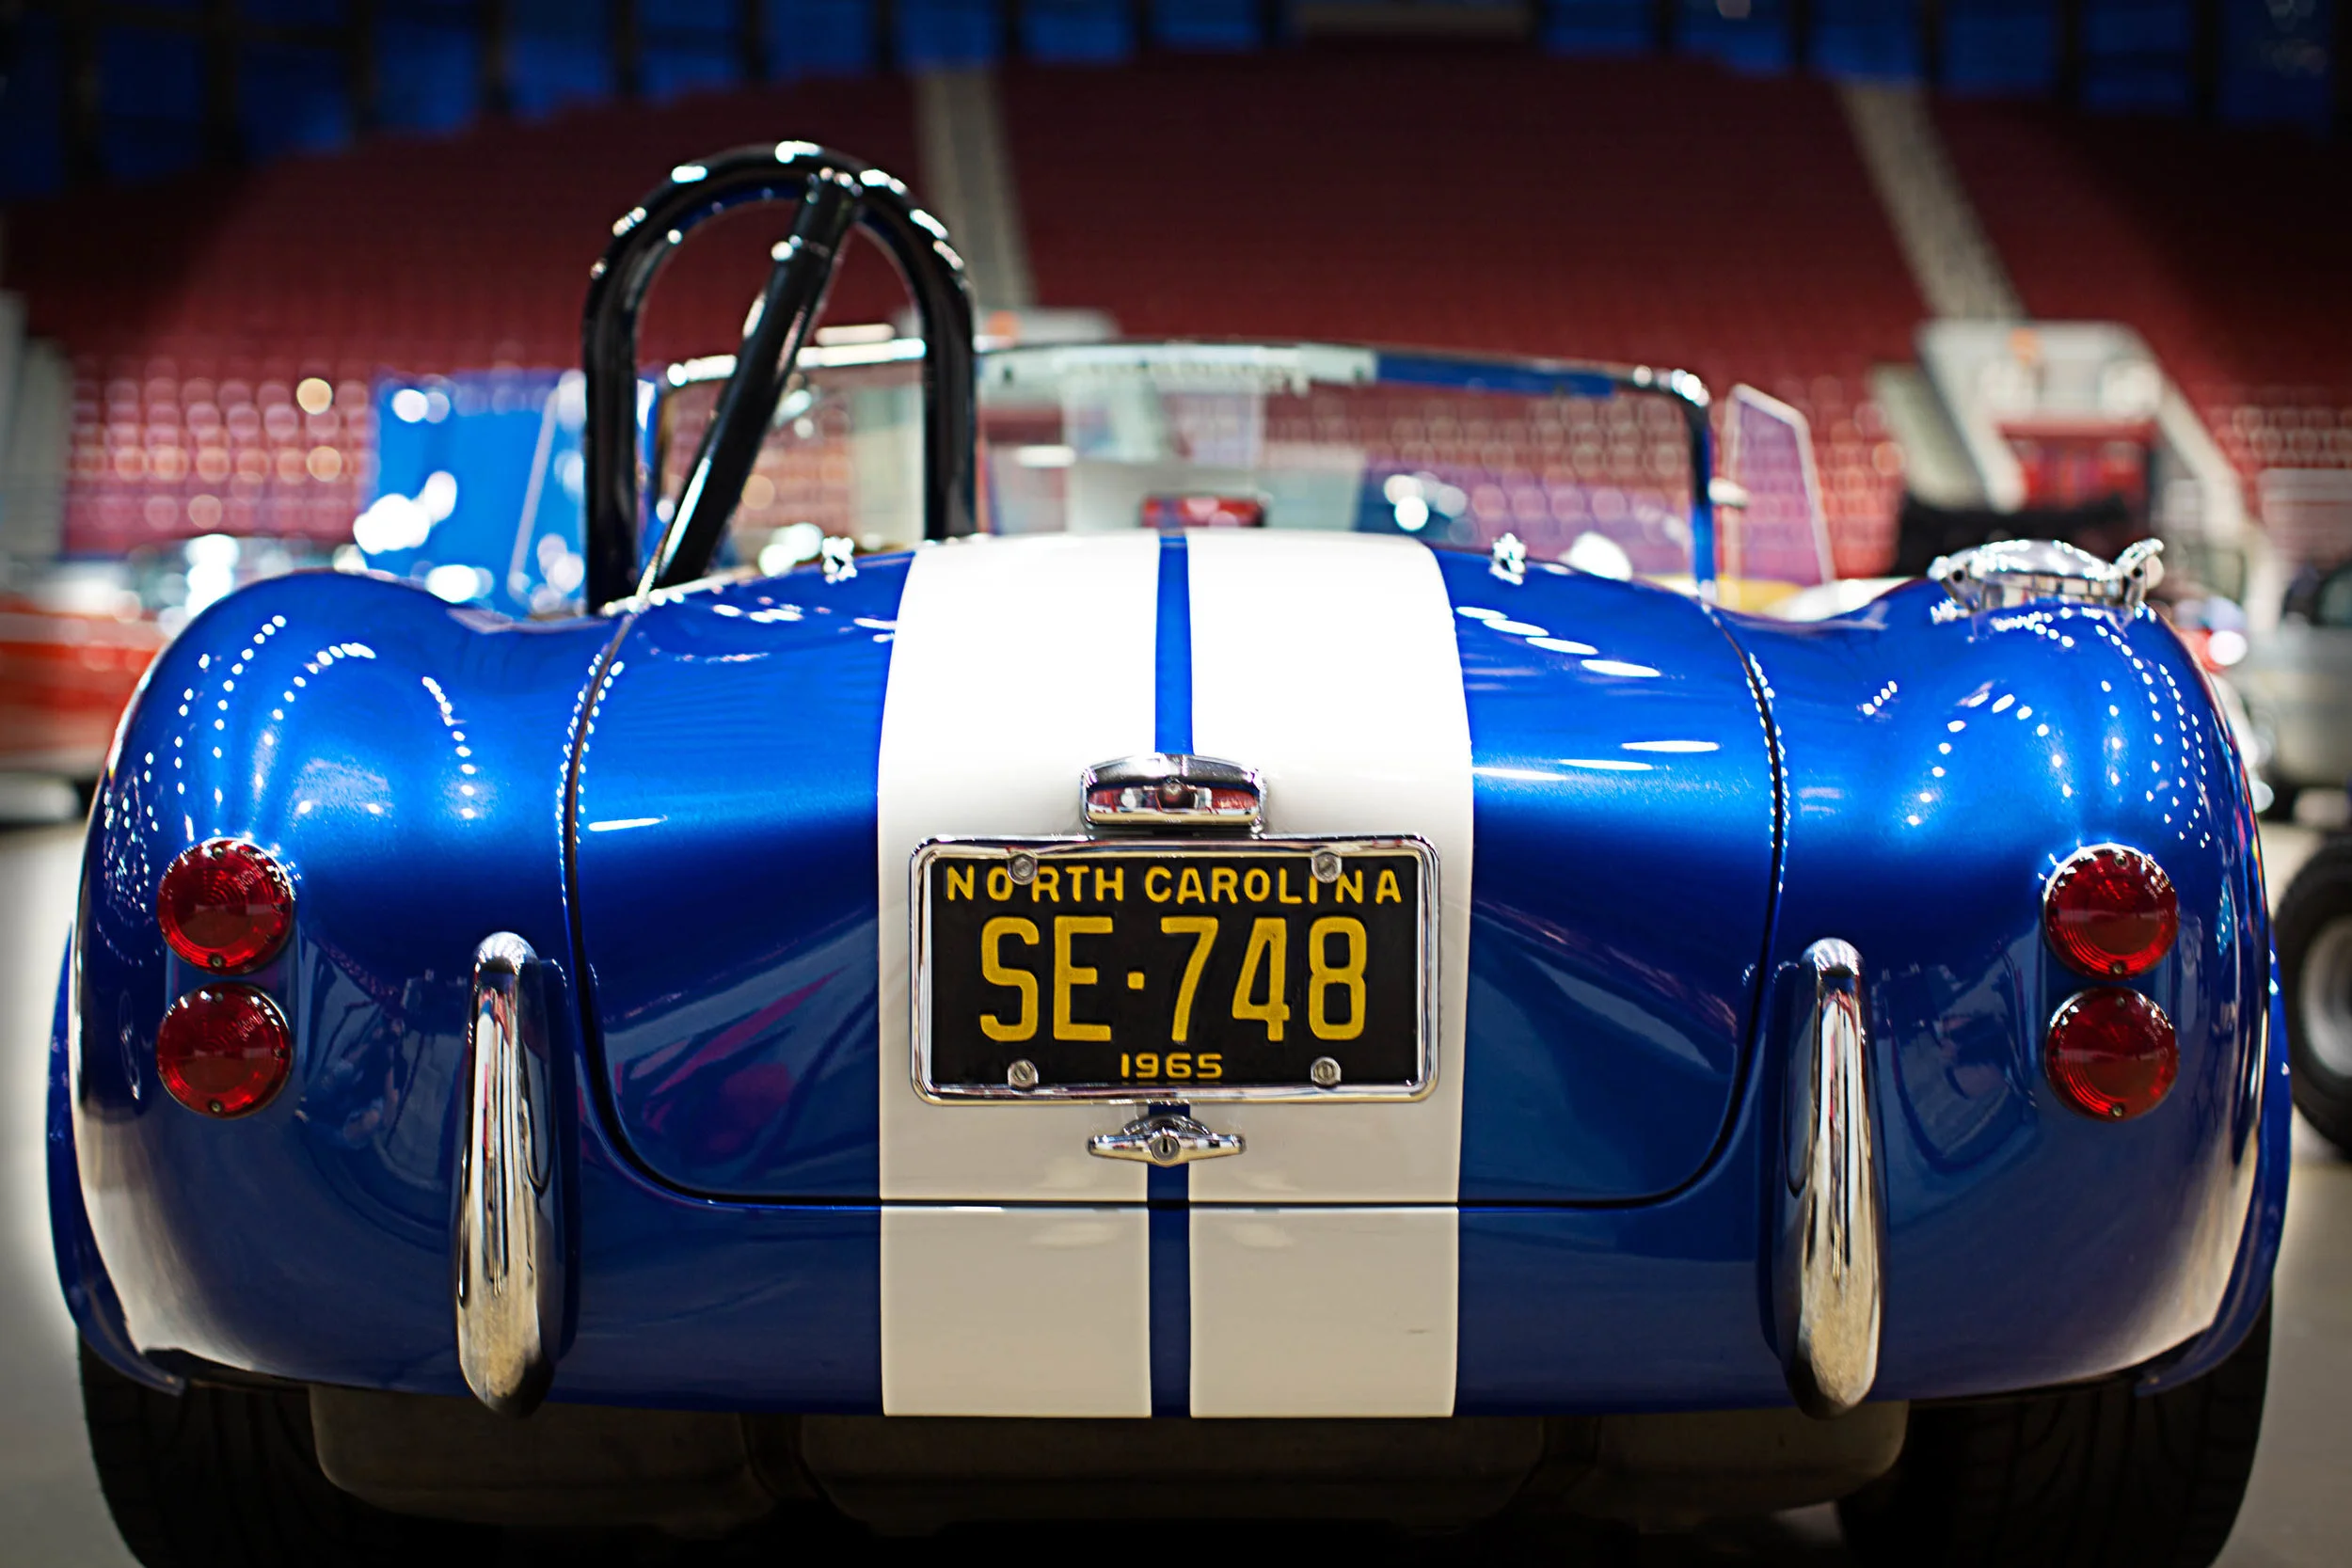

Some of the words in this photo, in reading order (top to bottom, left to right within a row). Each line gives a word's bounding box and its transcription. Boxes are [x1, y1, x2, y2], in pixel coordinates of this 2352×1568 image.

[946, 863, 1125, 903] NORTH
[1143, 865, 1403, 906] CAROLINA
[1120, 1052, 1224, 1080] 1965
